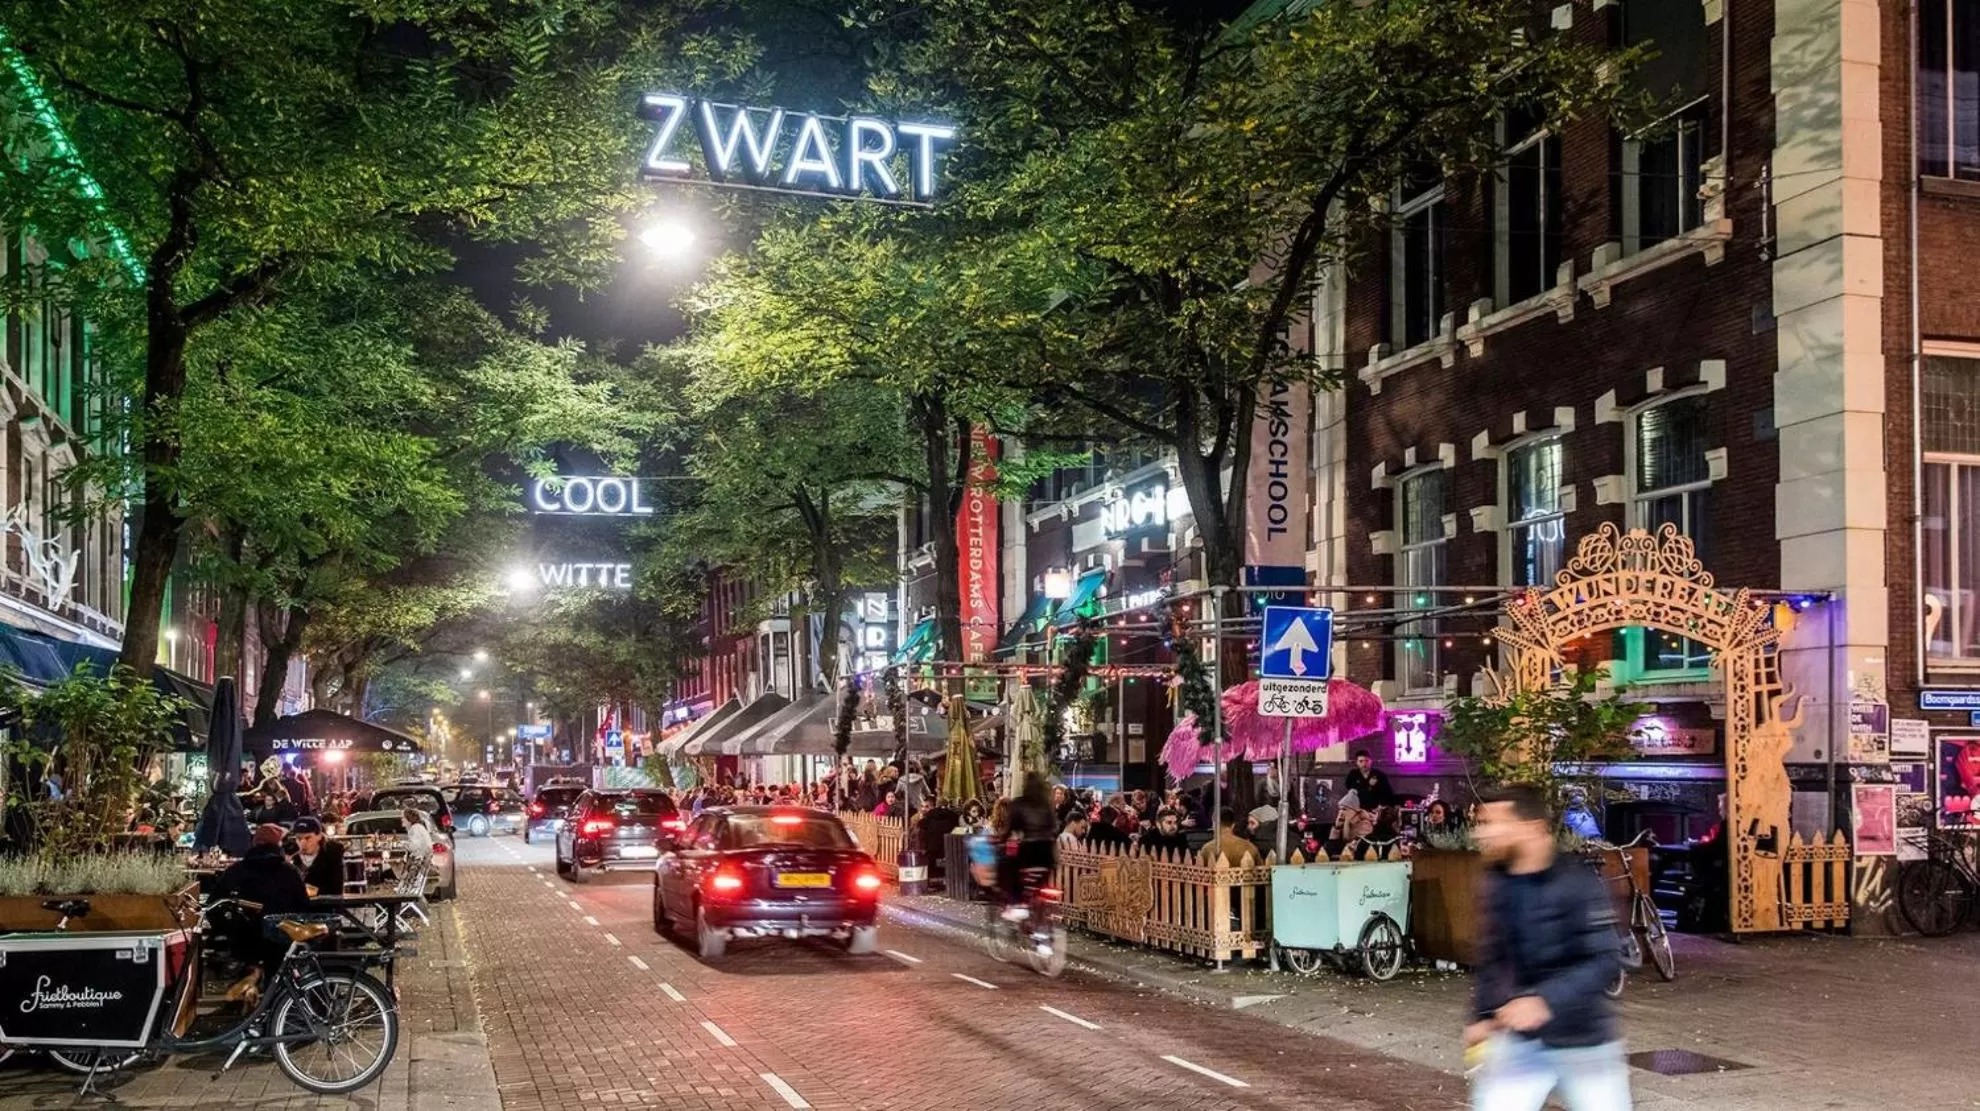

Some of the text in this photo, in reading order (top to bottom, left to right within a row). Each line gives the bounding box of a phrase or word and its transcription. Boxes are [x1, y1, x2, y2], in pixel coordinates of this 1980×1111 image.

[643, 94, 955, 197] ZWART
[534, 477, 654, 513] COOL
[969, 486, 985, 609] ROTTERDAMS
[539, 562, 631, 589] WITTE
[1550, 574, 1735, 619] WUNDERBAR
[1262, 682, 1327, 695] uitgezonderd
[272, 739, 288, 749] DE
[328, 739, 353, 749] AAP
